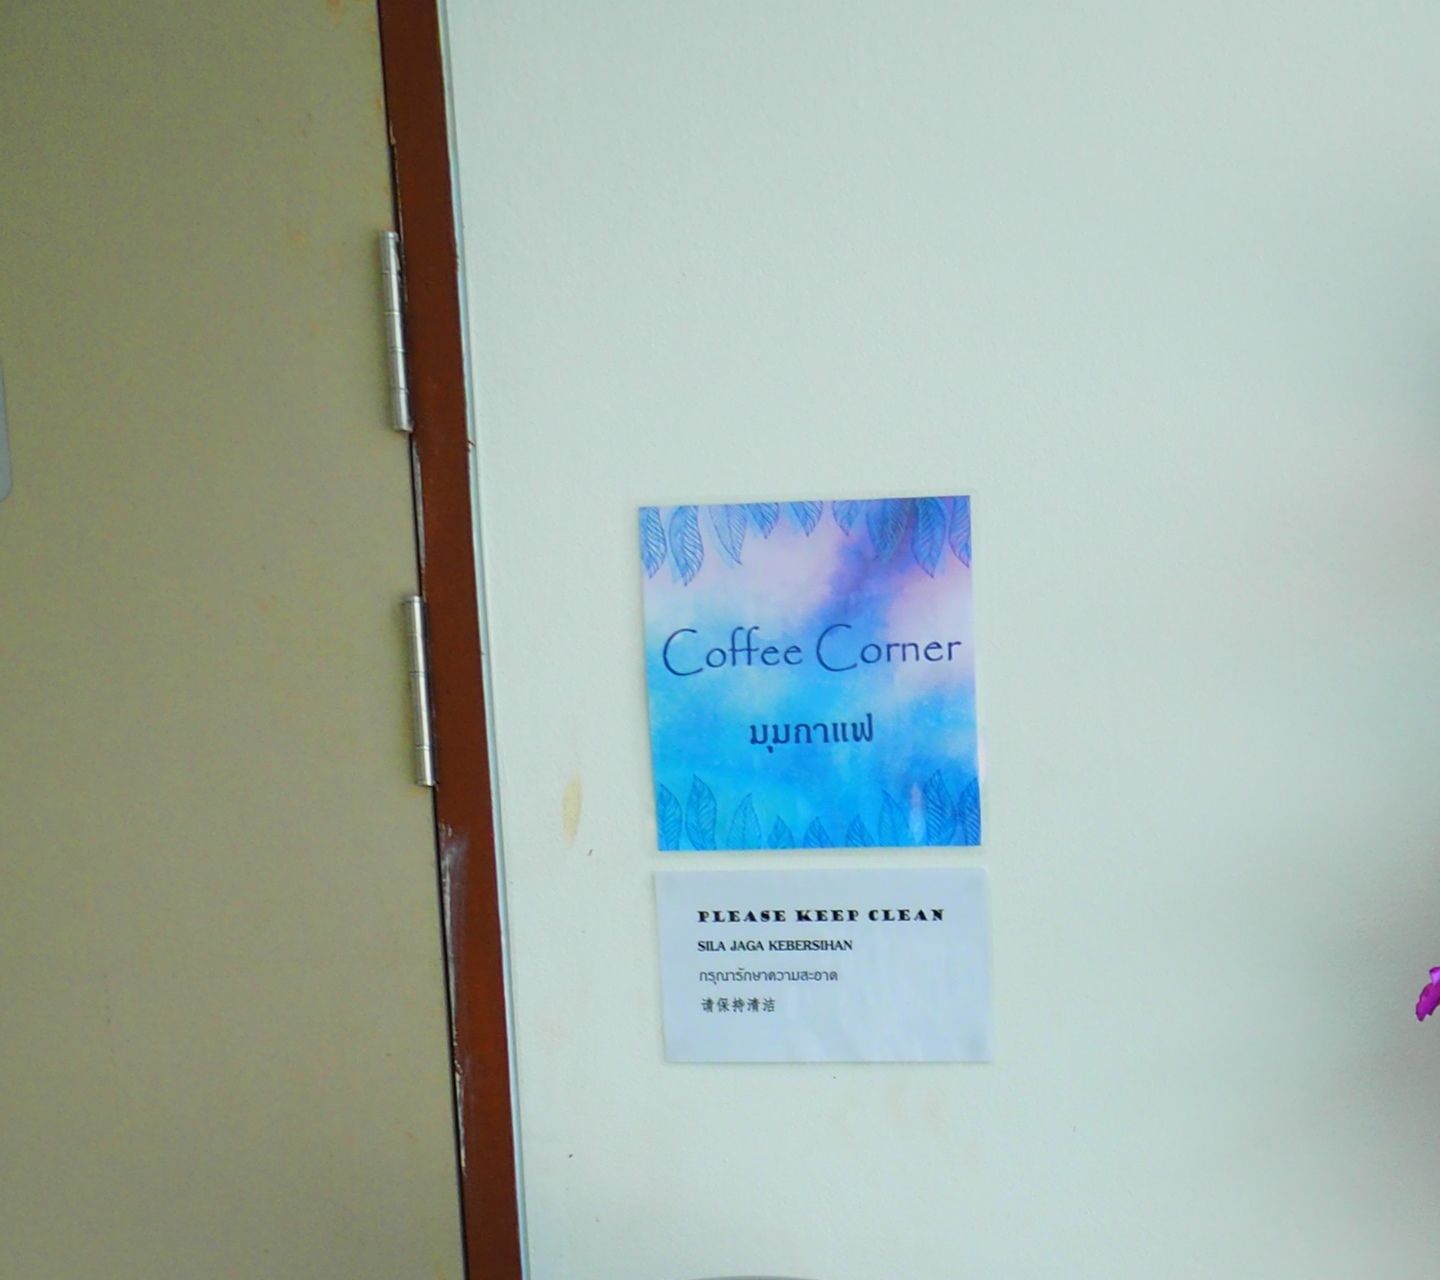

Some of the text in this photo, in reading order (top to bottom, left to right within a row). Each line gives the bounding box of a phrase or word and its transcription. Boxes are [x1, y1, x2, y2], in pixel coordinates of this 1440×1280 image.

[662, 623, 962, 677] Coffee Corner
[749, 713, 874, 753] มุมกาแฟ
[697, 909, 944, 923] PLEASE KEEP CLEAN
[697, 940, 853, 952] SILA JAGA KEBERSIHAN
[699, 967, 838, 985] กรุณารักษาความสะอาด
[701, 997, 776, 1013] 请保持清洁
